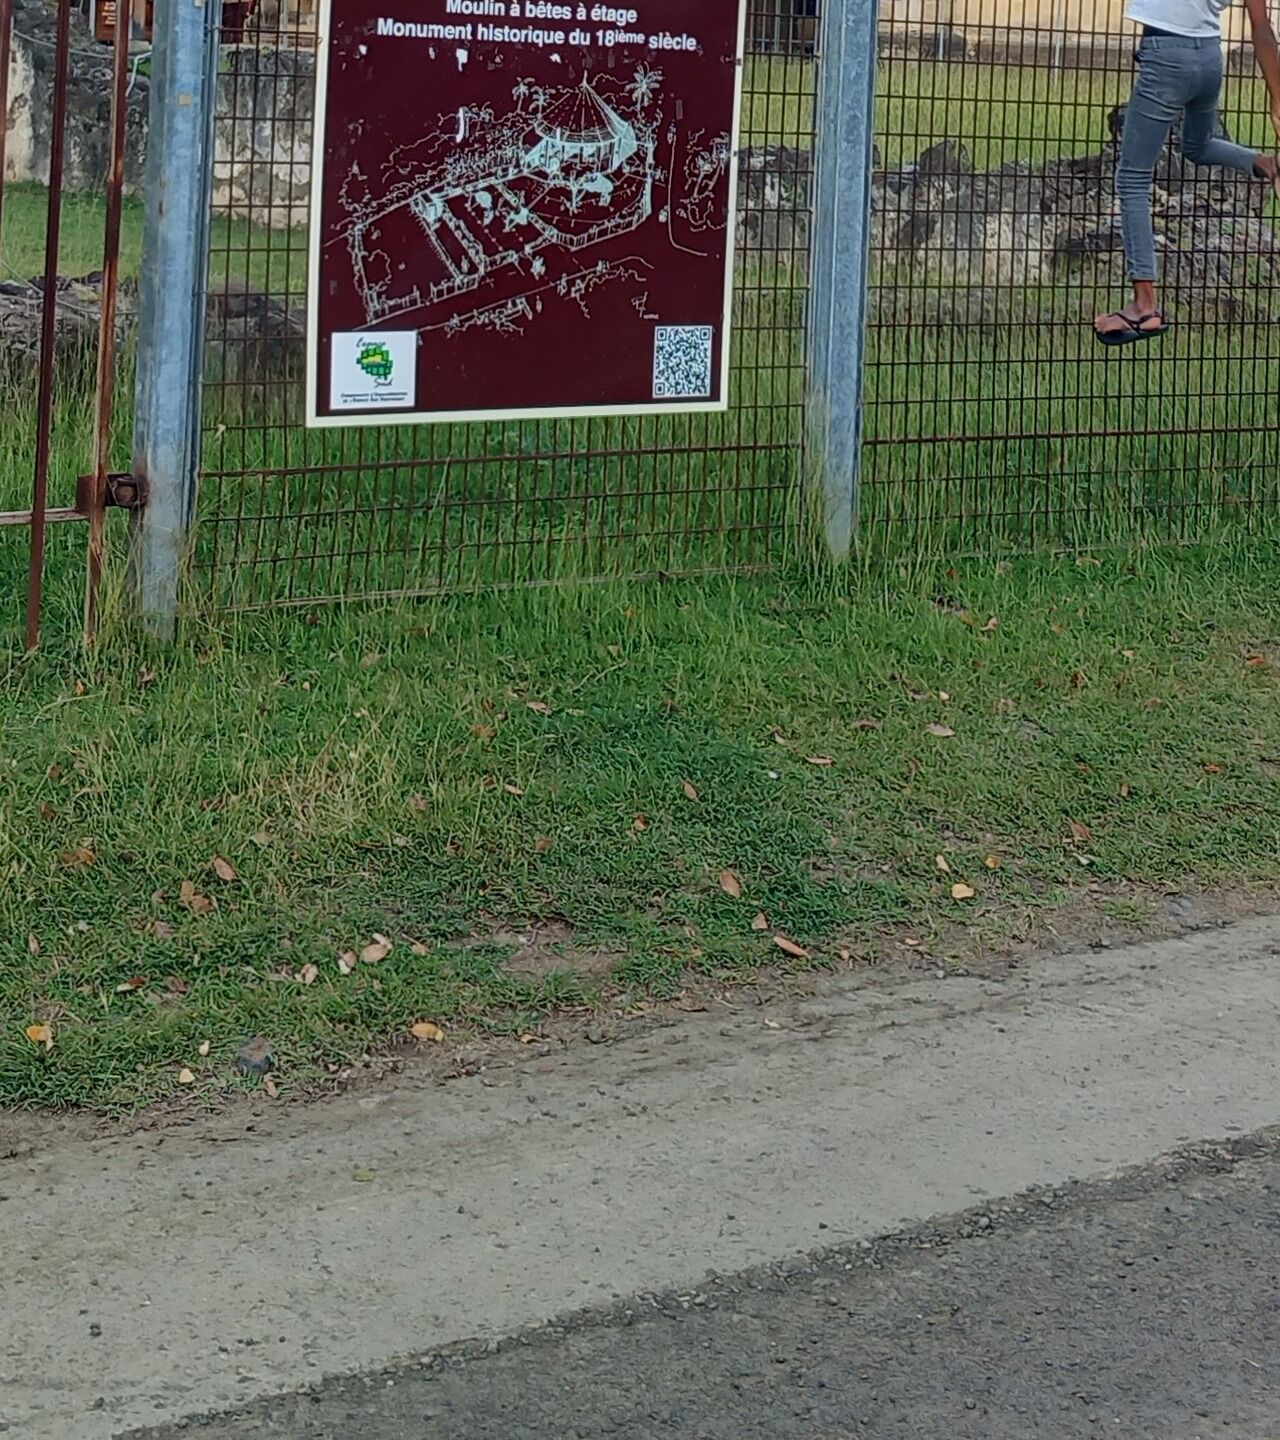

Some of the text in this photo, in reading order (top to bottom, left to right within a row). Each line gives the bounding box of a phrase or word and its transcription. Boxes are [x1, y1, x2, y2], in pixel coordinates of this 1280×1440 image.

[524, 0, 573, 20] bêtes
[575, 2, 587, 21] à
[590, 3, 638, 27] étage
[376, 17, 473, 41] Monument
[476, 22, 566, 48] historique
[568, 28, 591, 46] du
[648, 31, 697, 51] siècle
